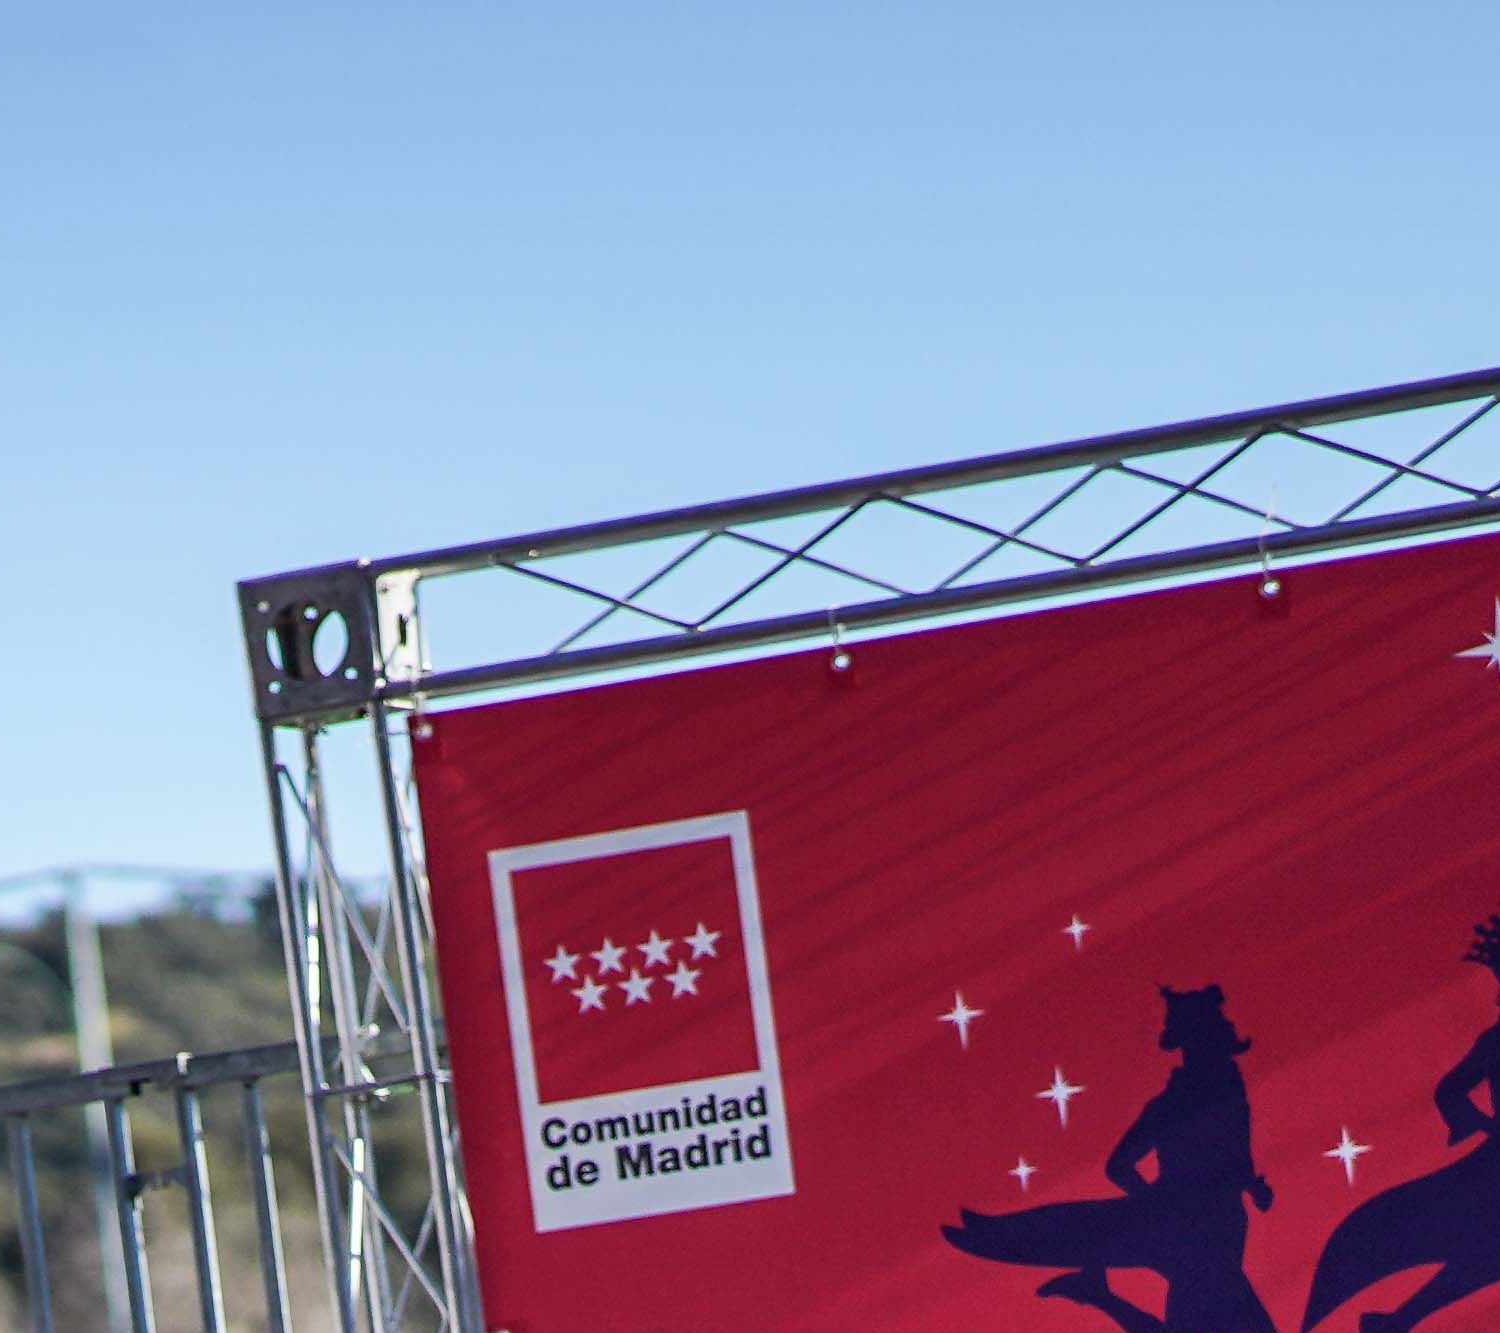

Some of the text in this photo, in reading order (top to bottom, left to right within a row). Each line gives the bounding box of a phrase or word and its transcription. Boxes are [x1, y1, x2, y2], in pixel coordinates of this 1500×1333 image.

[541, 1086, 768, 1150] Comunidad
[546, 1124, 772, 1192] de Madrid
